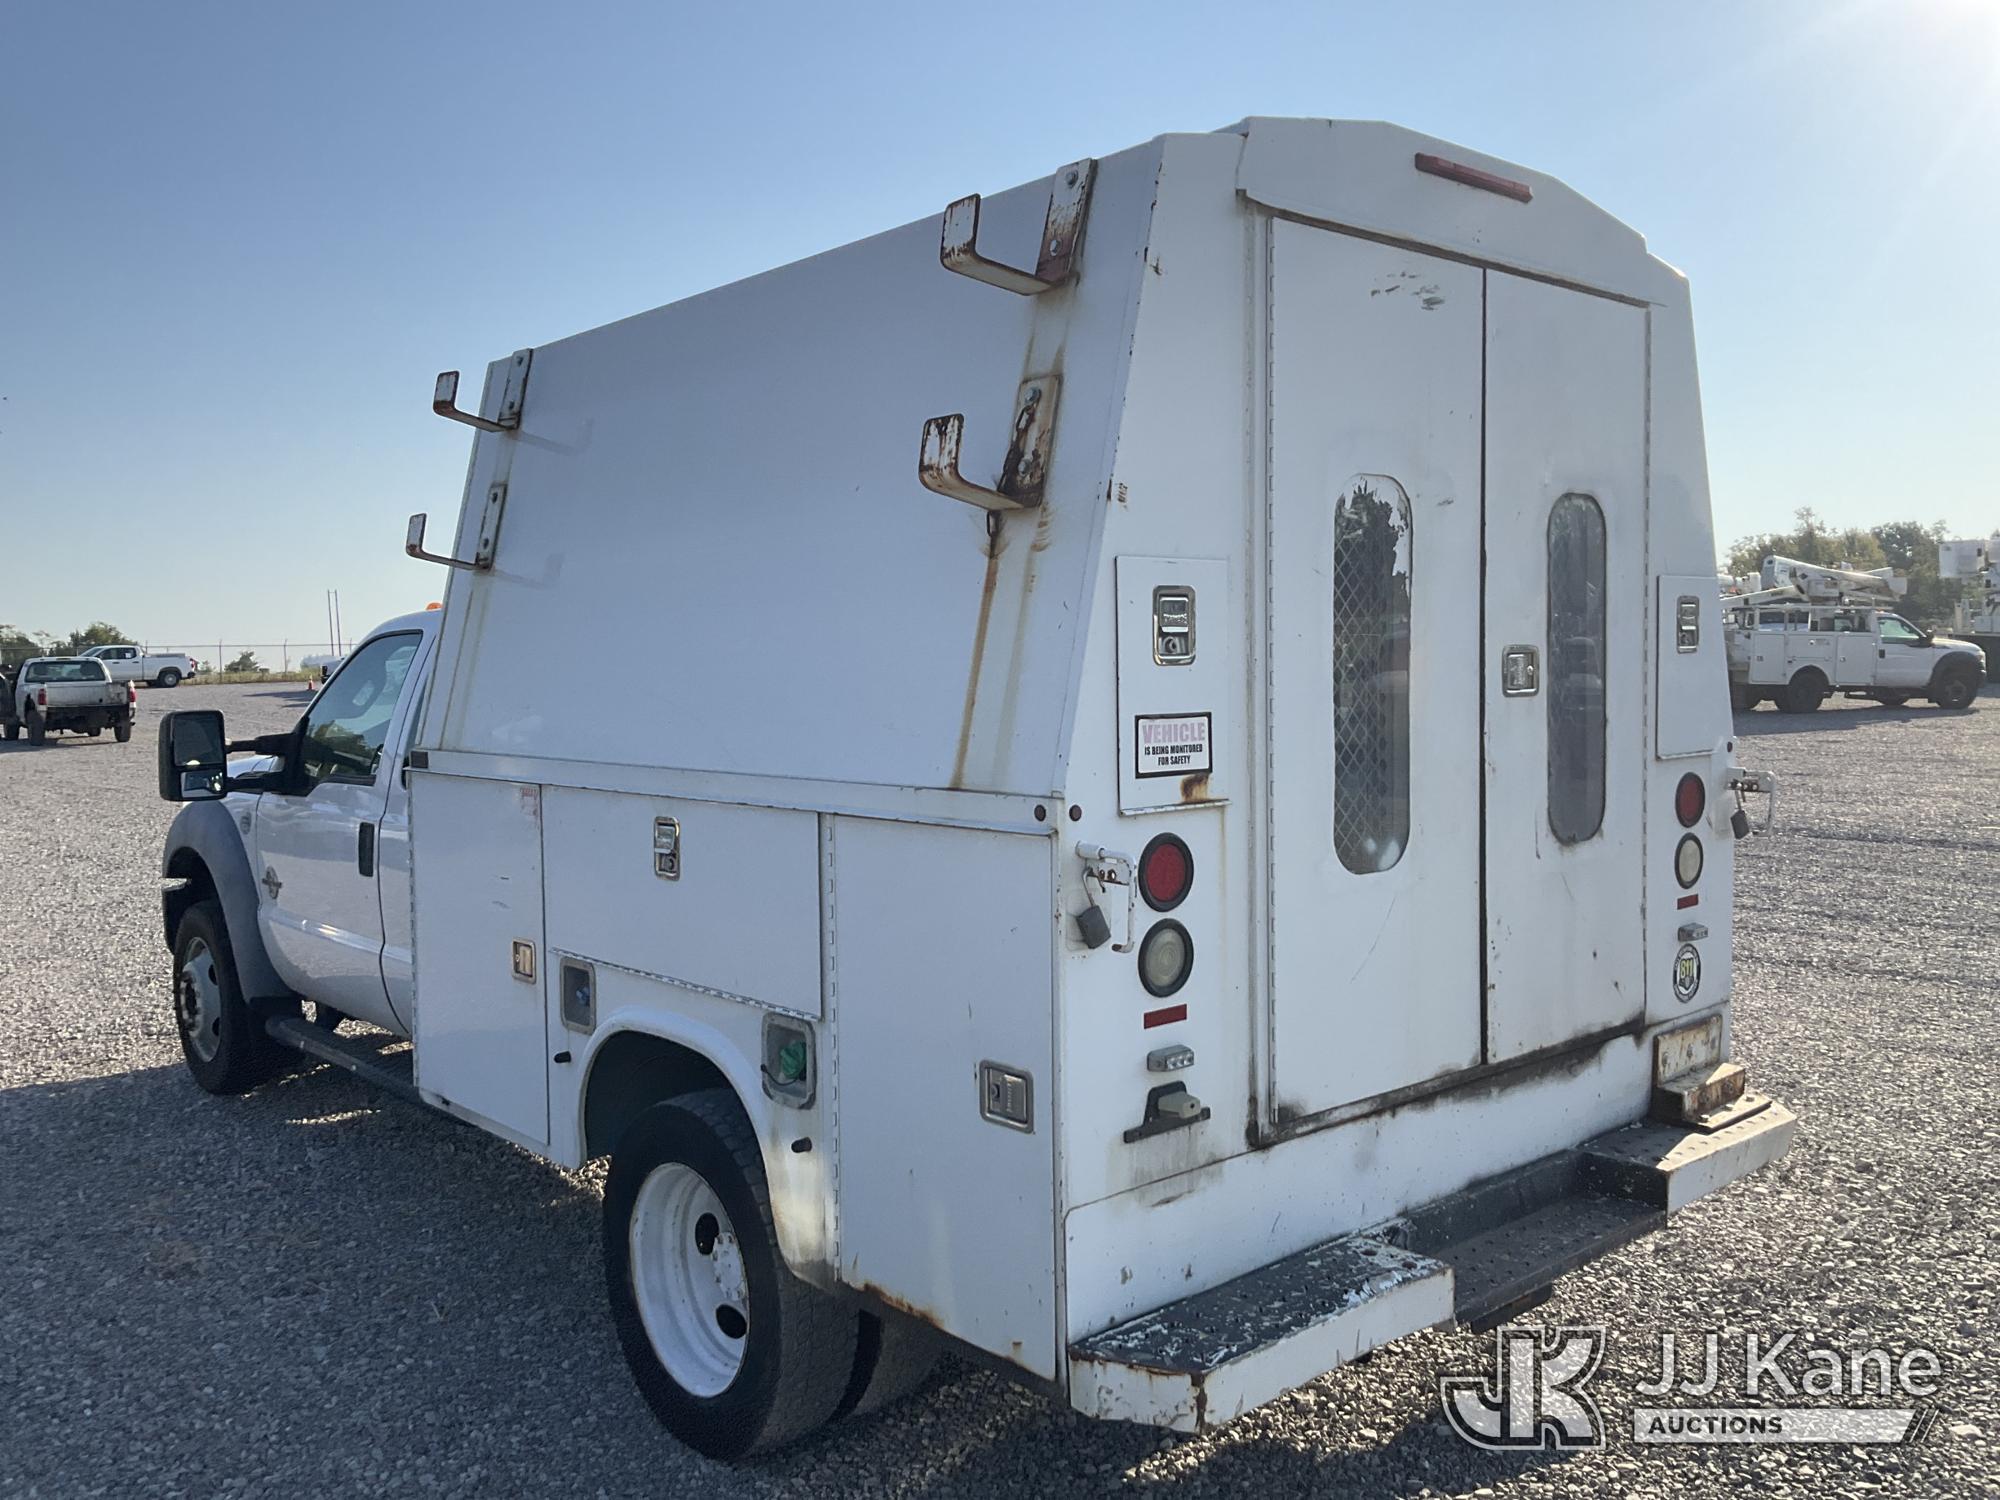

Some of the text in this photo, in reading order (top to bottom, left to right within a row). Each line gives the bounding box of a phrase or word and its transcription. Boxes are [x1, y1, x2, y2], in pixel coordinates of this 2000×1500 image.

[1142, 722, 1205, 744] VEHICLE
[1145, 744, 1202, 755] IS BEING MONITORED
[1158, 755, 1191, 766] FOR SAFETY
[1680, 959, 1693, 978] 811
